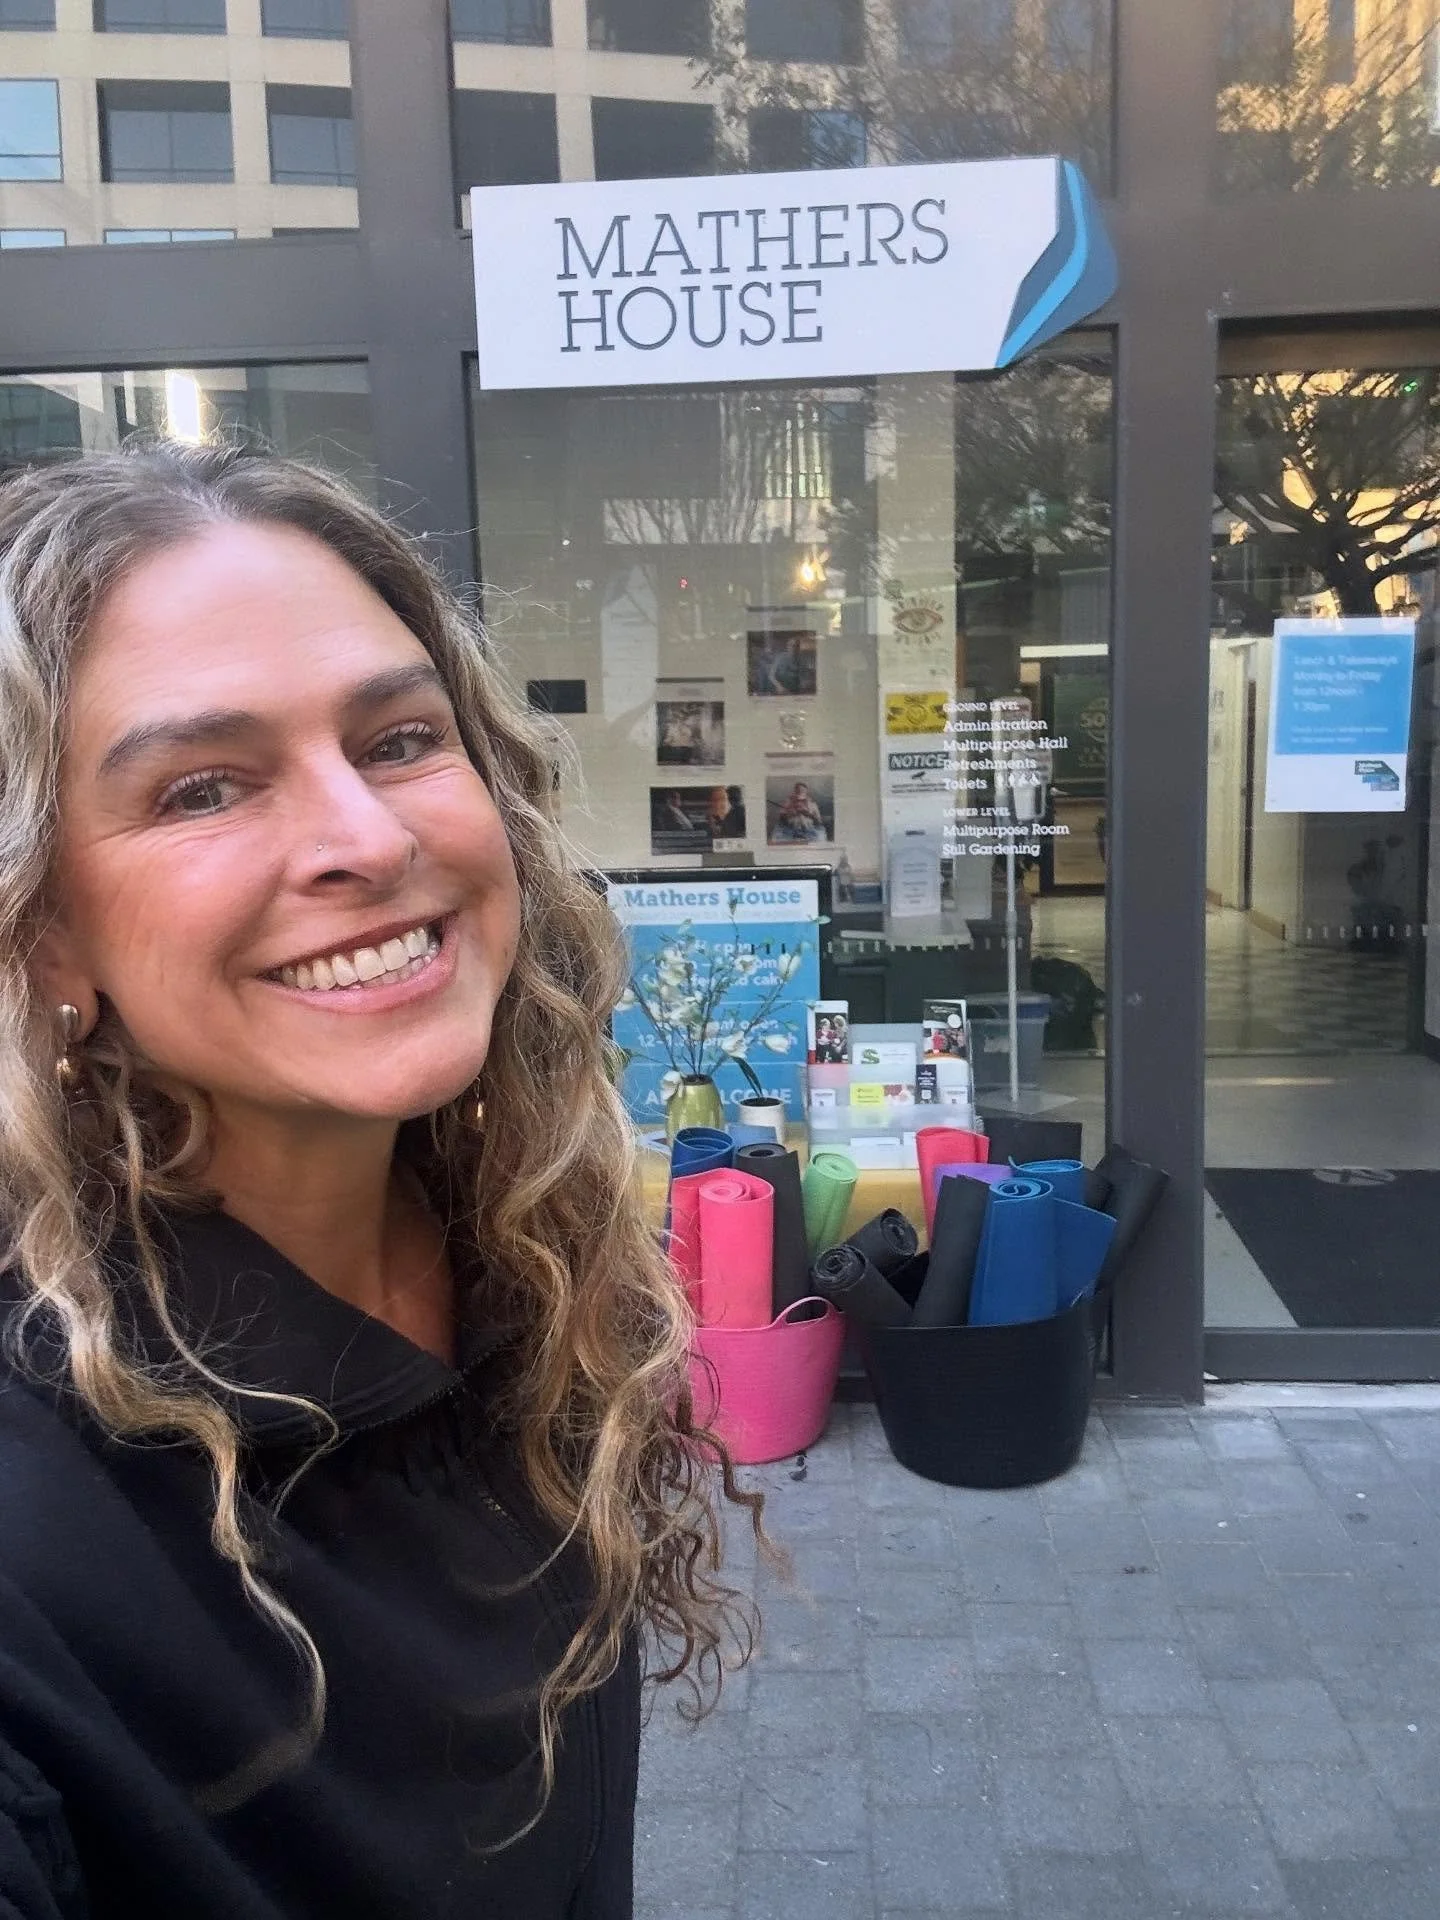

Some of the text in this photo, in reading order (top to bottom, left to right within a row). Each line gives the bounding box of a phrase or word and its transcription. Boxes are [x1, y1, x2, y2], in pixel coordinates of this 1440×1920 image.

[555, 199, 949, 280] MATHERS
[558, 280, 823, 353] HOUSE
[943, 700, 1020, 712] GROUND LEVEL
[944, 719, 1048, 732] Administration
[943, 737, 1068, 753] Multipurpose Hall
[890, 754, 946, 768] NOTICE
[944, 757, 1037, 770] Refreshments
[943, 777, 987, 790] Toilets
[943, 807, 1011, 817] LOWER LEVEL
[943, 824, 1070, 838] Multipurpose Room
[943, 843, 1041, 857] Still Gardening
[624, 887, 801, 907] Mathers House
